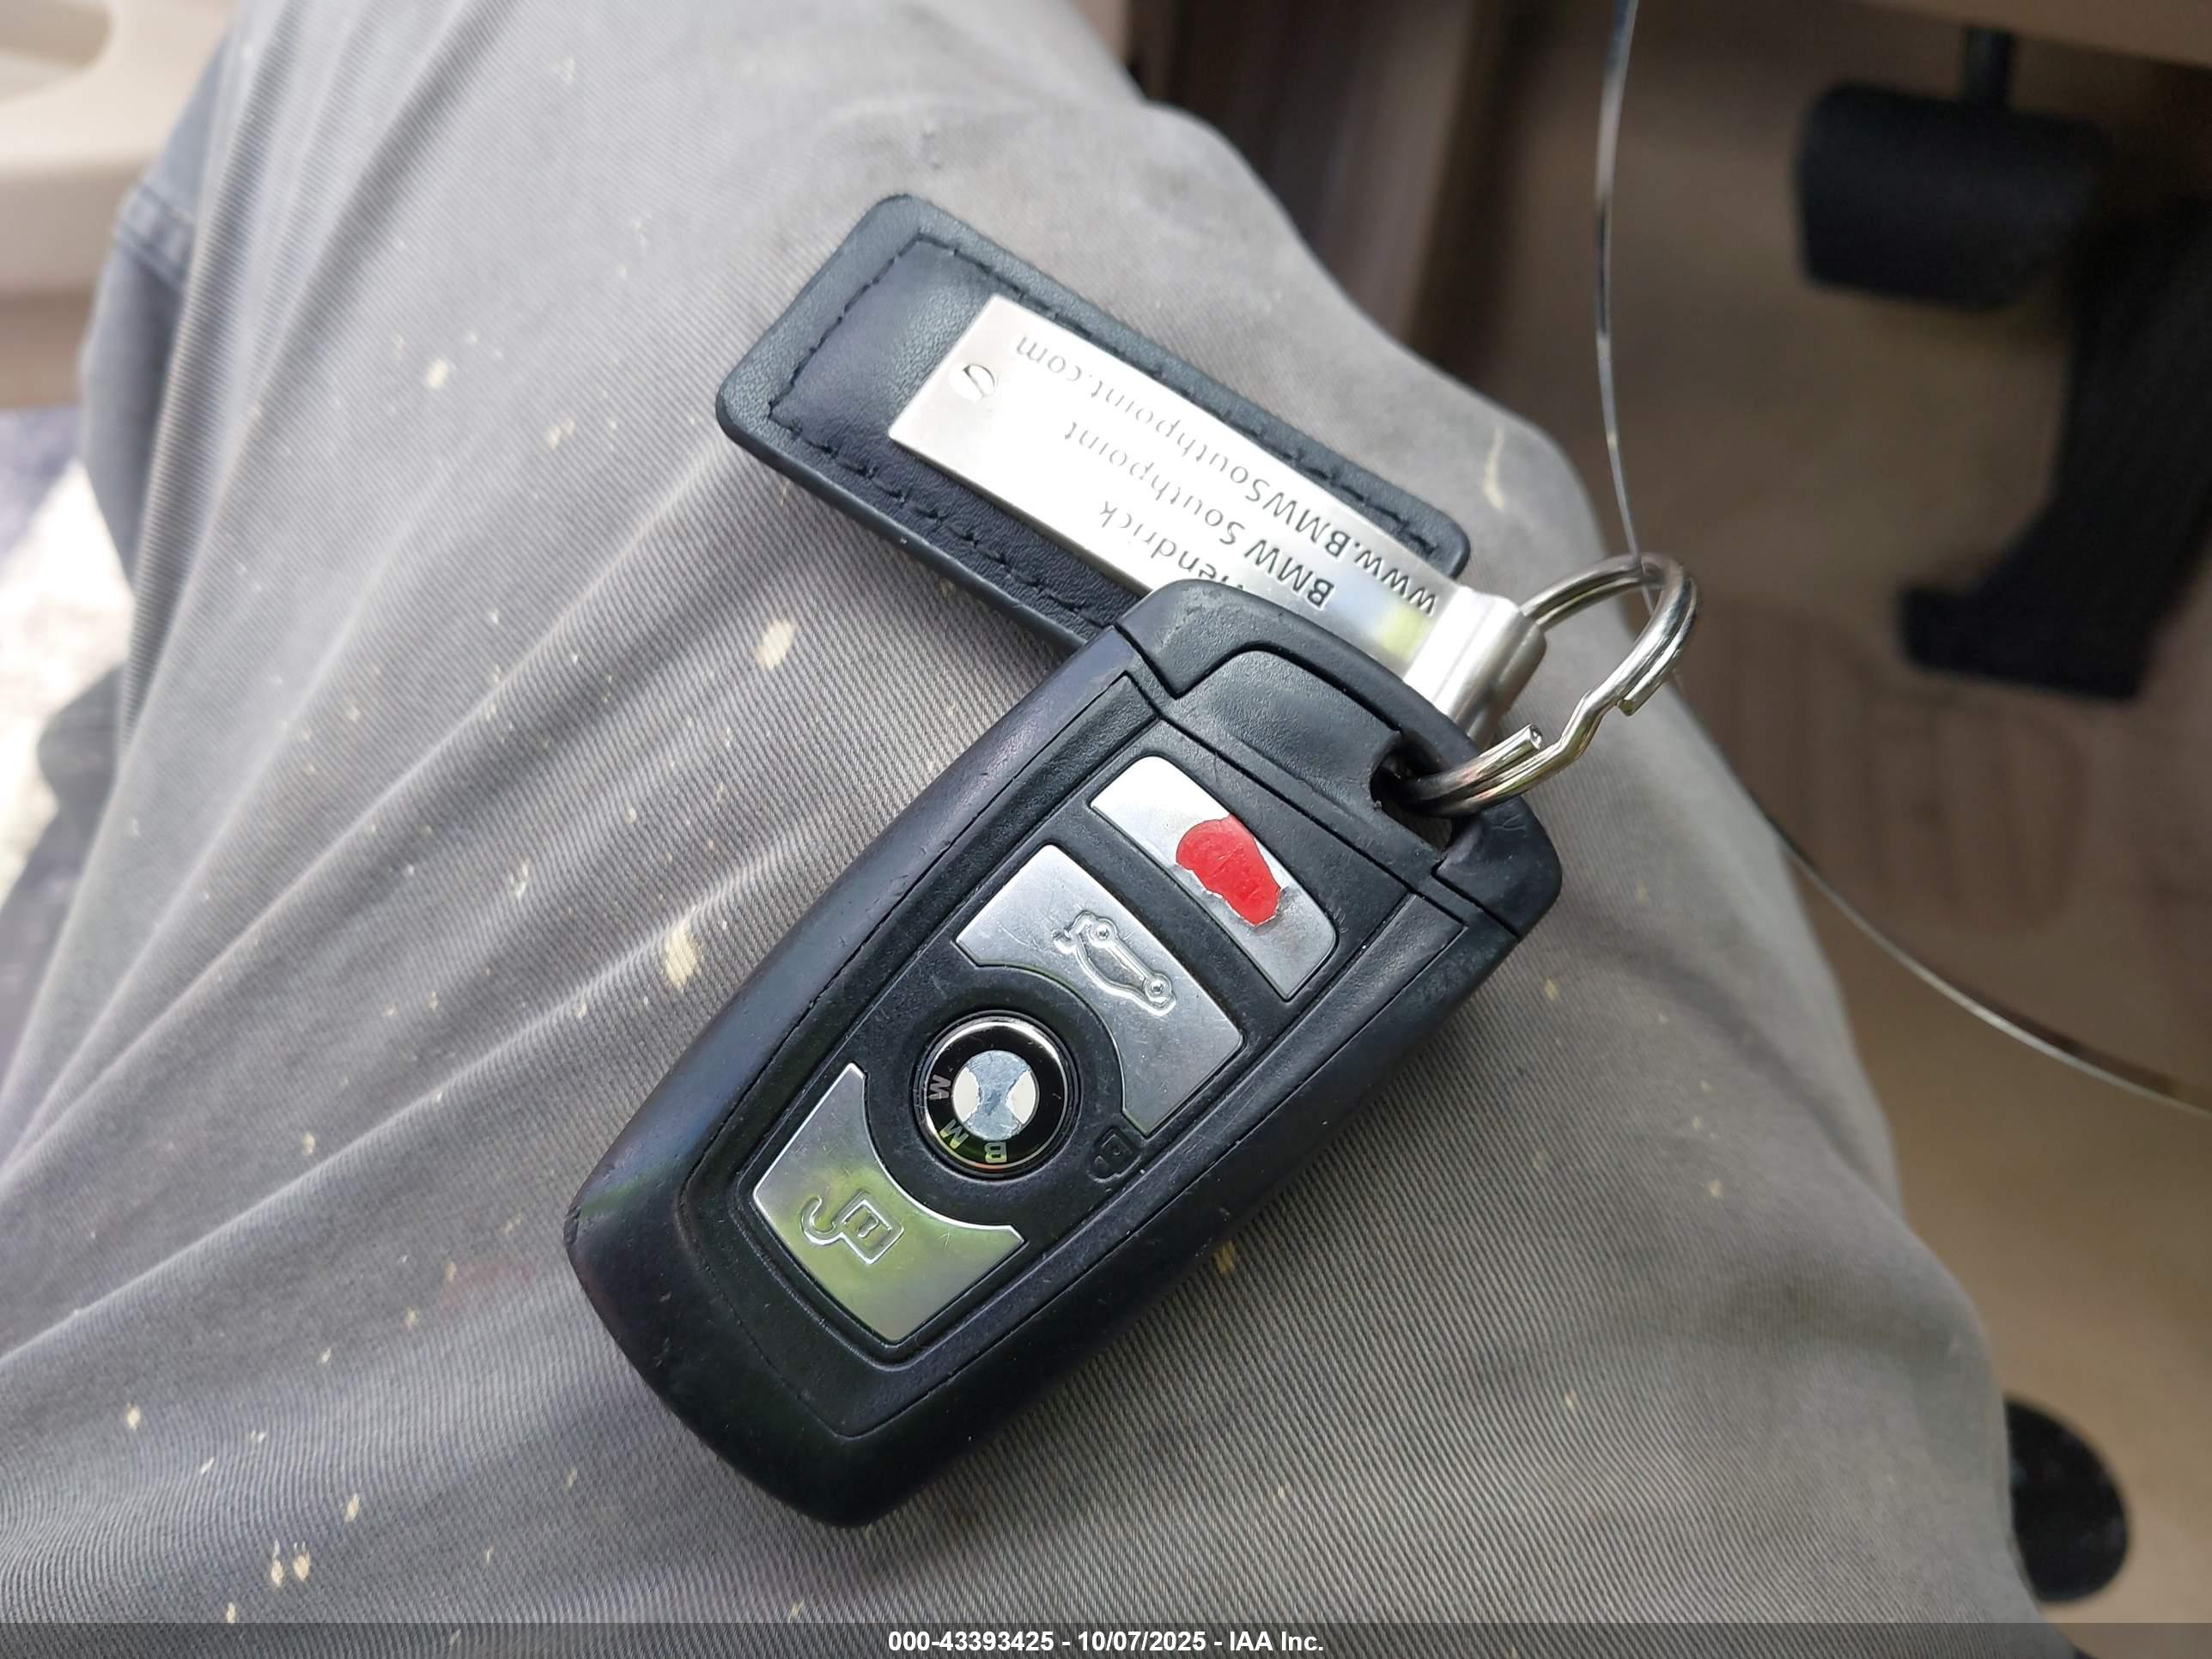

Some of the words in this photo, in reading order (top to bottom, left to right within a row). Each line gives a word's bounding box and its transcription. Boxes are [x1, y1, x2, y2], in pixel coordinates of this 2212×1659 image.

[1016, 336, 1437, 615] www.BMWSouthpoint.com
[1064, 421, 1246, 545] Southpoint
[1099, 501, 1244, 591] endrick
[1243, 538, 1335, 609] BMW
[927, 1073, 1008, 1164] BMW
